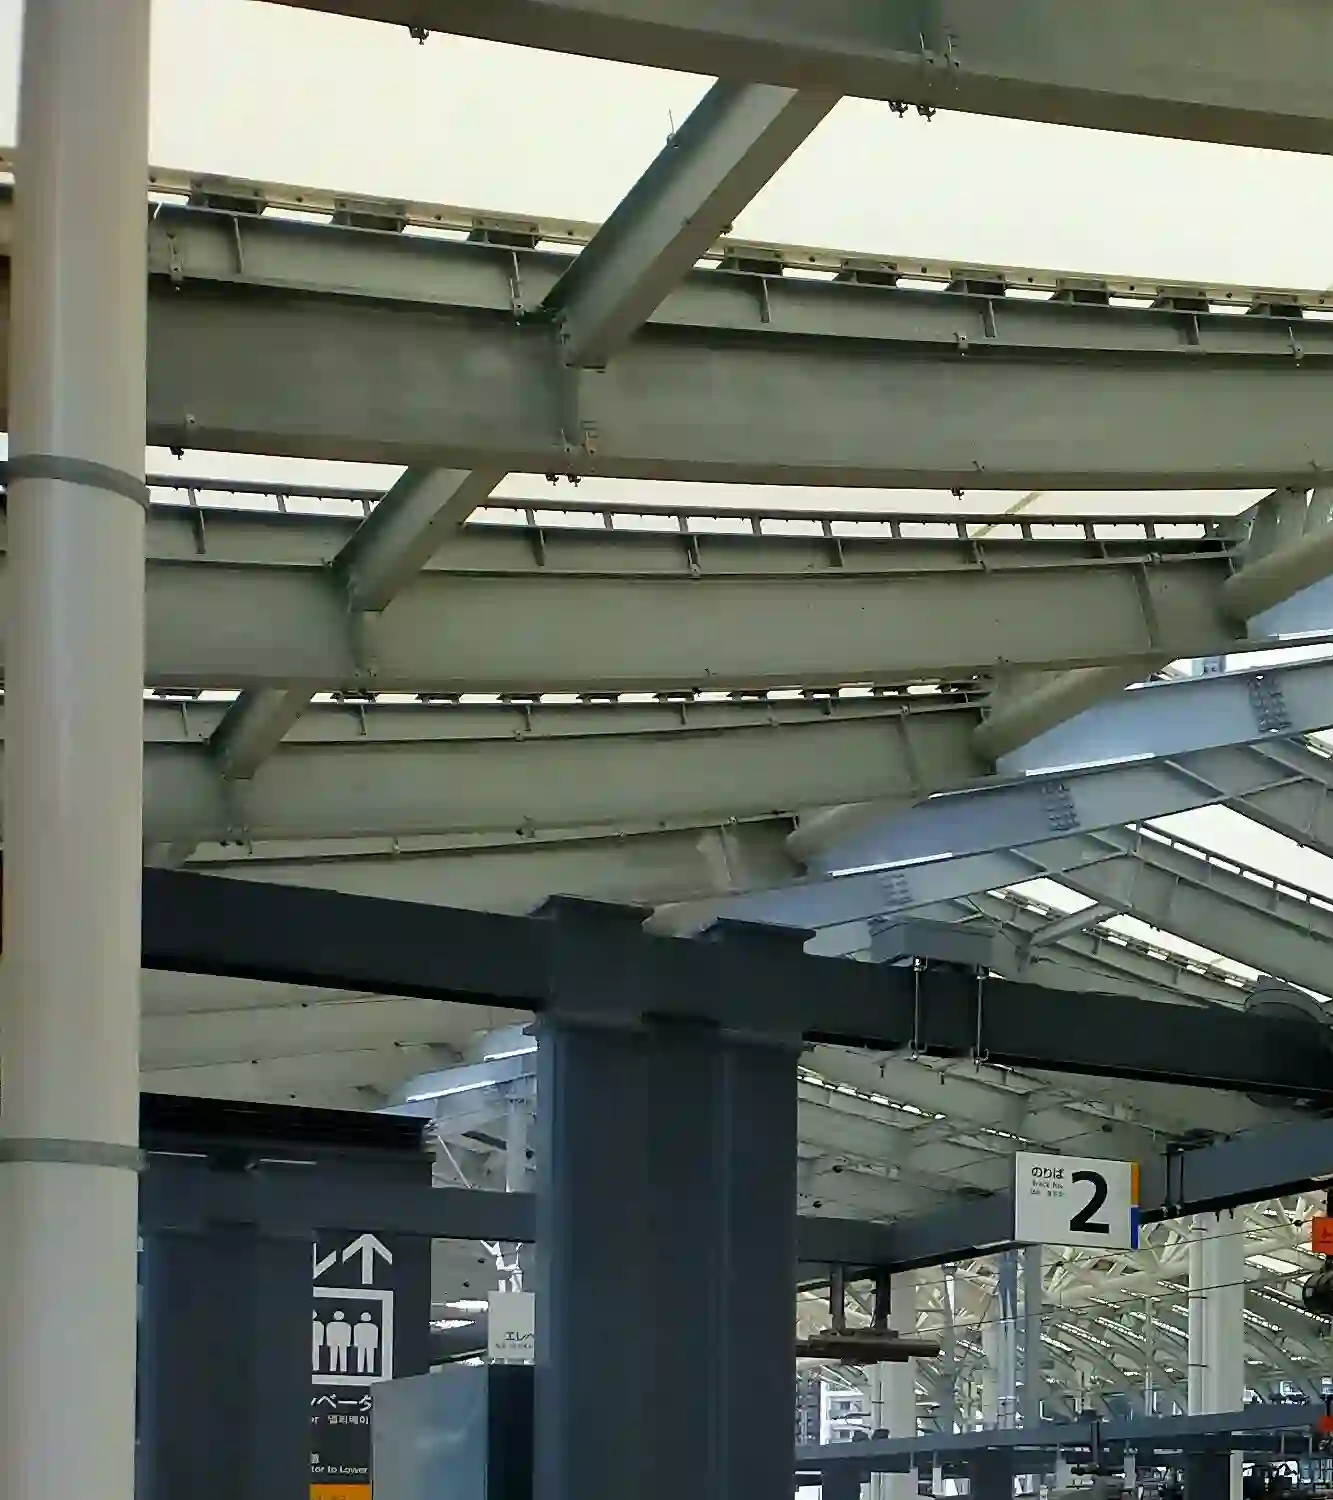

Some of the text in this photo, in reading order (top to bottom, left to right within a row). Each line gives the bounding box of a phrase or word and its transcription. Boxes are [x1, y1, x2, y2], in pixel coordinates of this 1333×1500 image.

[1031, 1166, 1064, 1179] のりば
[1069, 1170, 1110, 1234] 2
